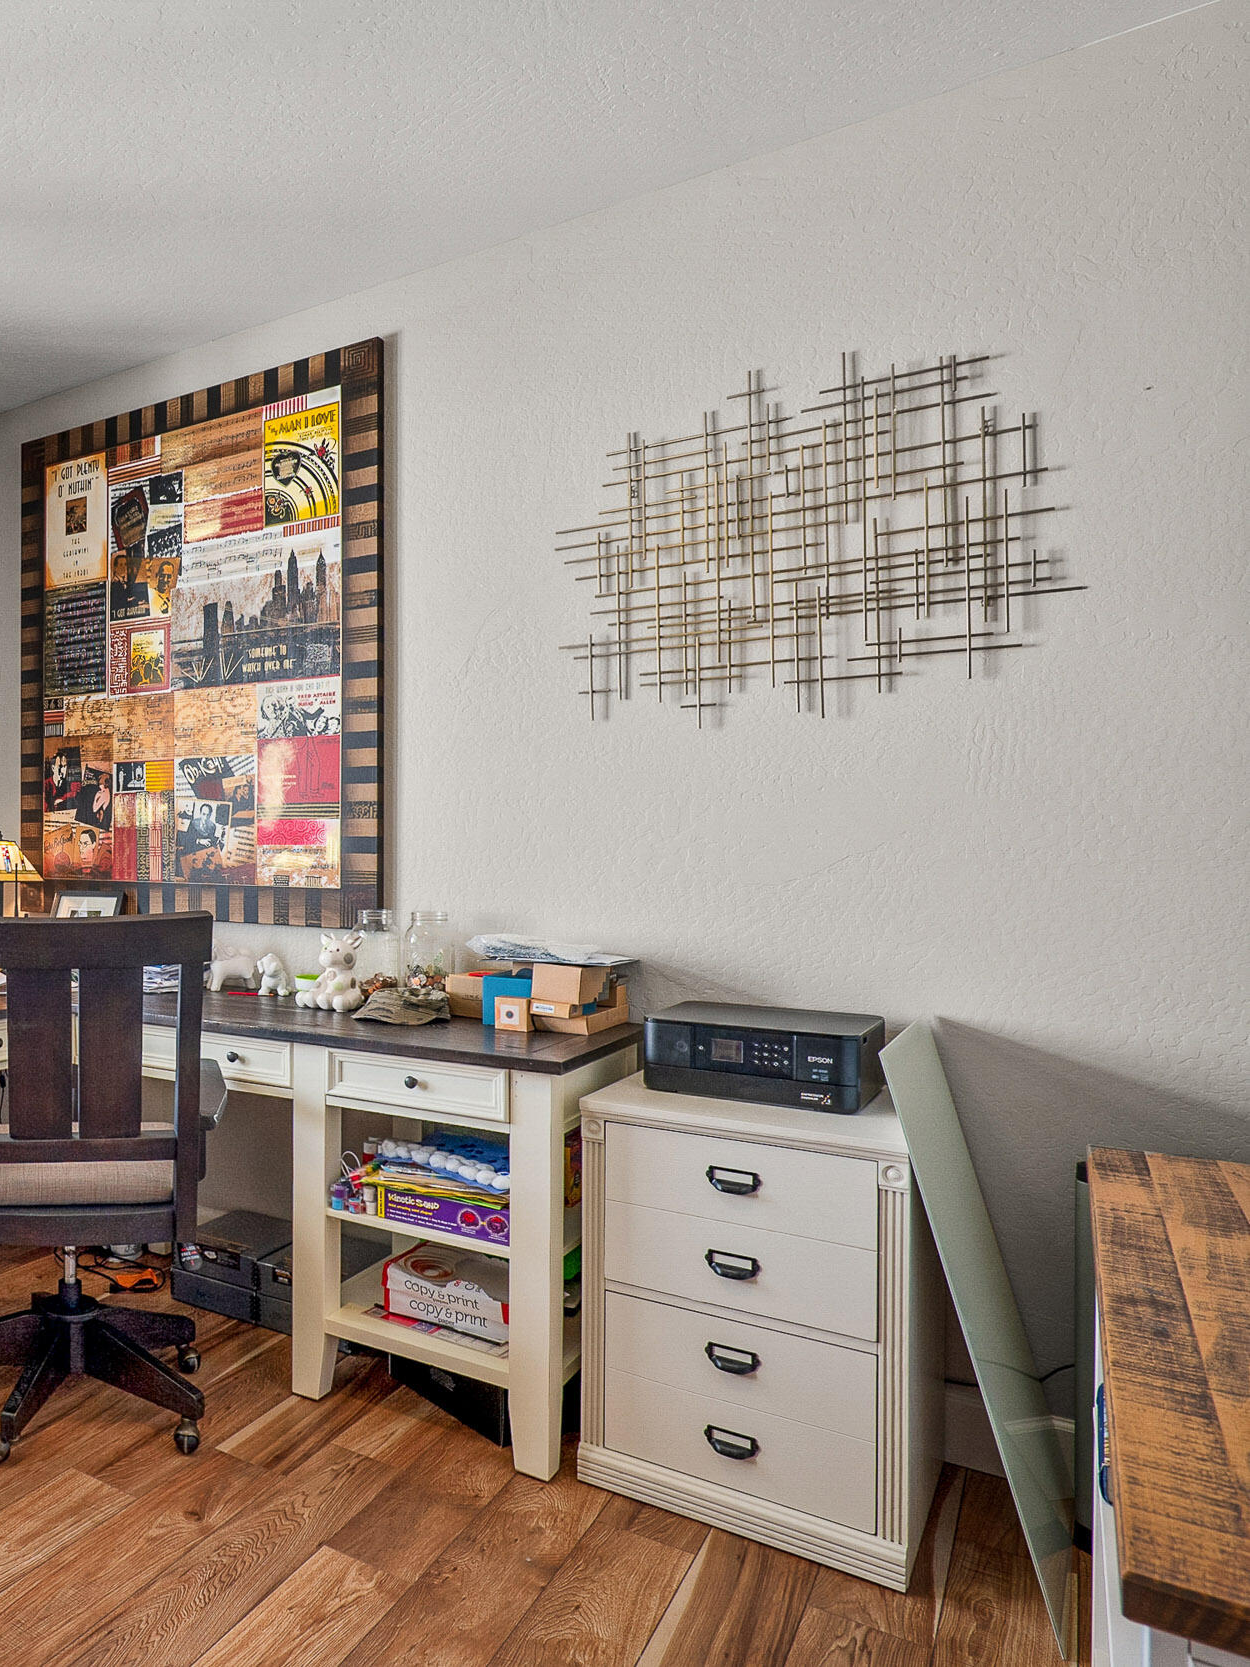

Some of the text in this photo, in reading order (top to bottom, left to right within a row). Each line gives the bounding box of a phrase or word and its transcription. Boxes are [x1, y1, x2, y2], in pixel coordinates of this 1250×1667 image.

[278, 418, 302, 435] MAN
[311, 409, 337, 428] LOVE
[61, 466, 73, 480] GOT
[76, 459, 100, 477] PLENTY
[807, 1055, 834, 1064] EPSON
[387, 1192, 416, 1205] Kinetic
[404, 1279, 435, 1299] copy
[437, 1290, 445, 1300] &
[446, 1293, 480, 1311] print
[409, 1299, 488, 1328] copy & print
